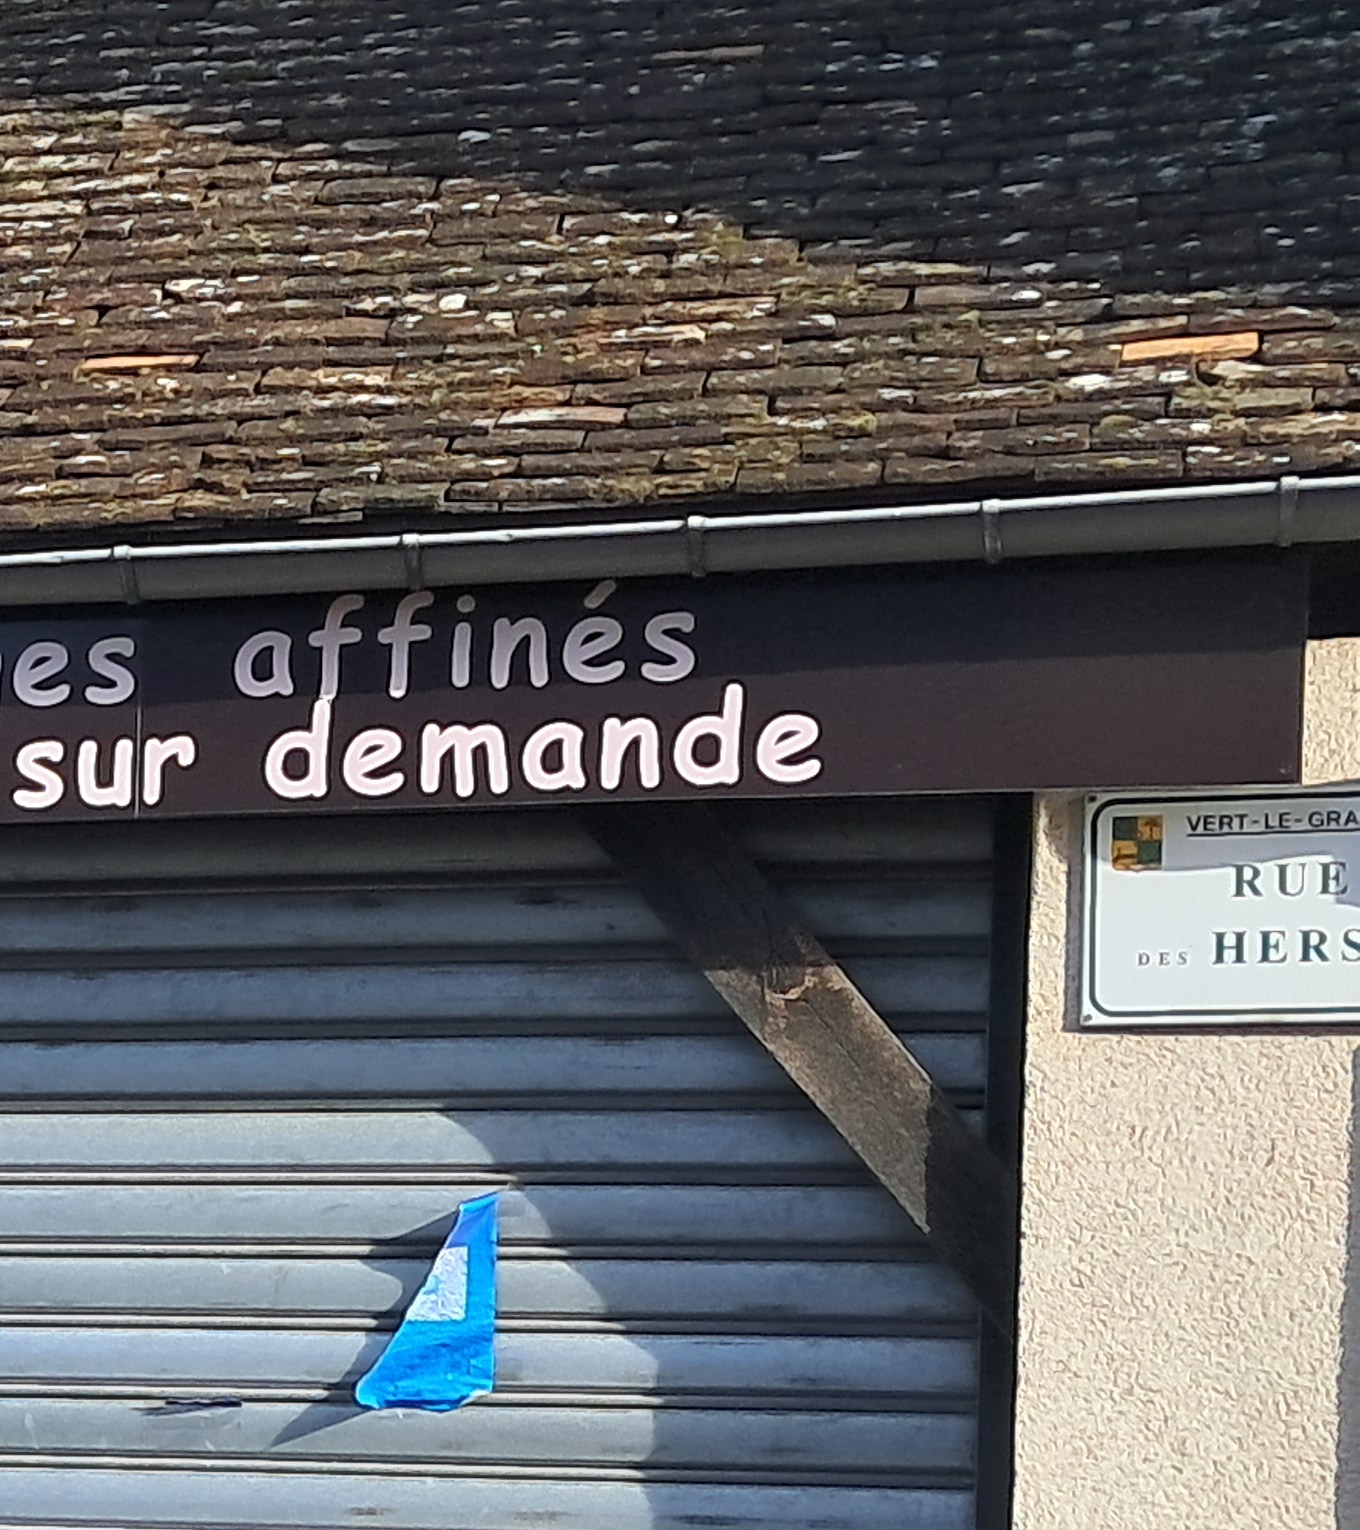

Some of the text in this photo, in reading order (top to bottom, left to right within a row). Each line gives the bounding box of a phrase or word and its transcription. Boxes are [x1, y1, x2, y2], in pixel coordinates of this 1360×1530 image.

[232, 579, 697, 700] affinés
[12, 735, 197, 812] sur
[262, 682, 823, 799] demande
[1185, 810, 1359, 832] VERT-LE-GRA
[1231, 860, 1349, 898] RUE
[1136, 928, 1360, 967] DES HERS
